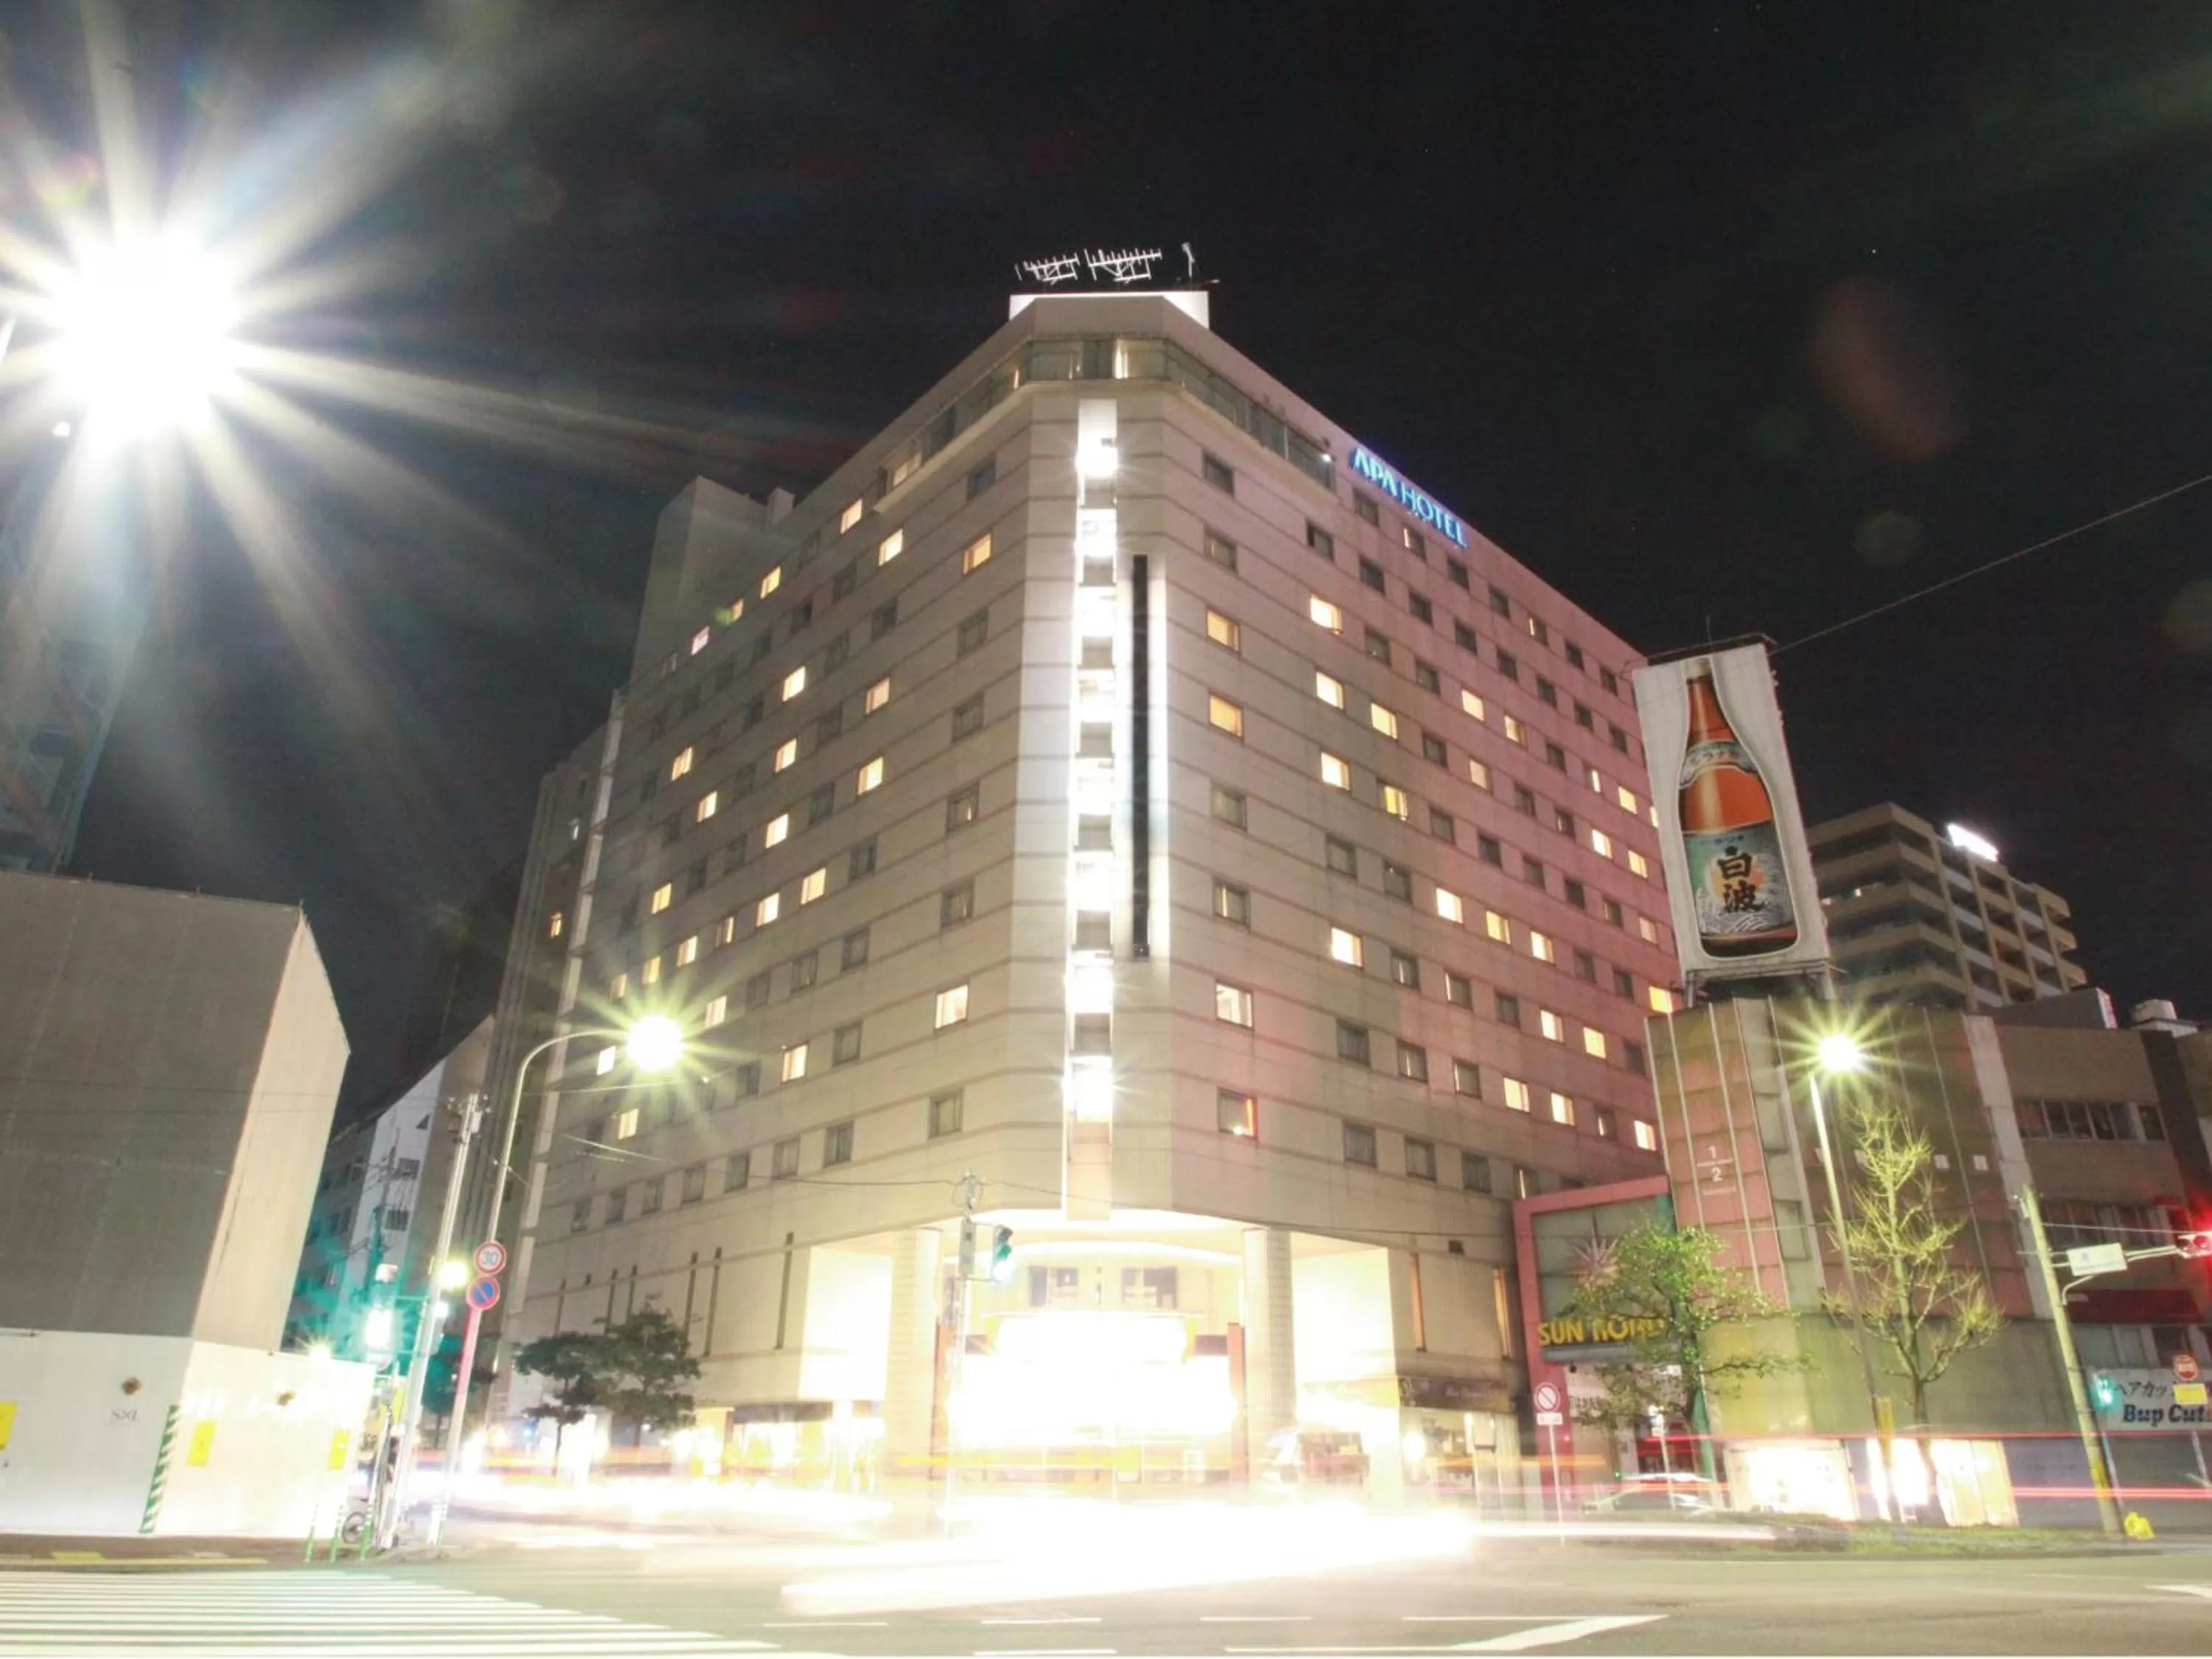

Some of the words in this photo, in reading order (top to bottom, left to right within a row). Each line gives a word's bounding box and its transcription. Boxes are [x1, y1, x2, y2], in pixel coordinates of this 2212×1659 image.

[1351, 447, 1398, 497] APA
[1399, 480, 1469, 549] HOTEL
[1717, 845, 1764, 913] 白波
[1708, 1145, 1717, 1159] 1
[1711, 1166, 1723, 1183] 2
[1539, 1319, 1585, 1346] SUN
